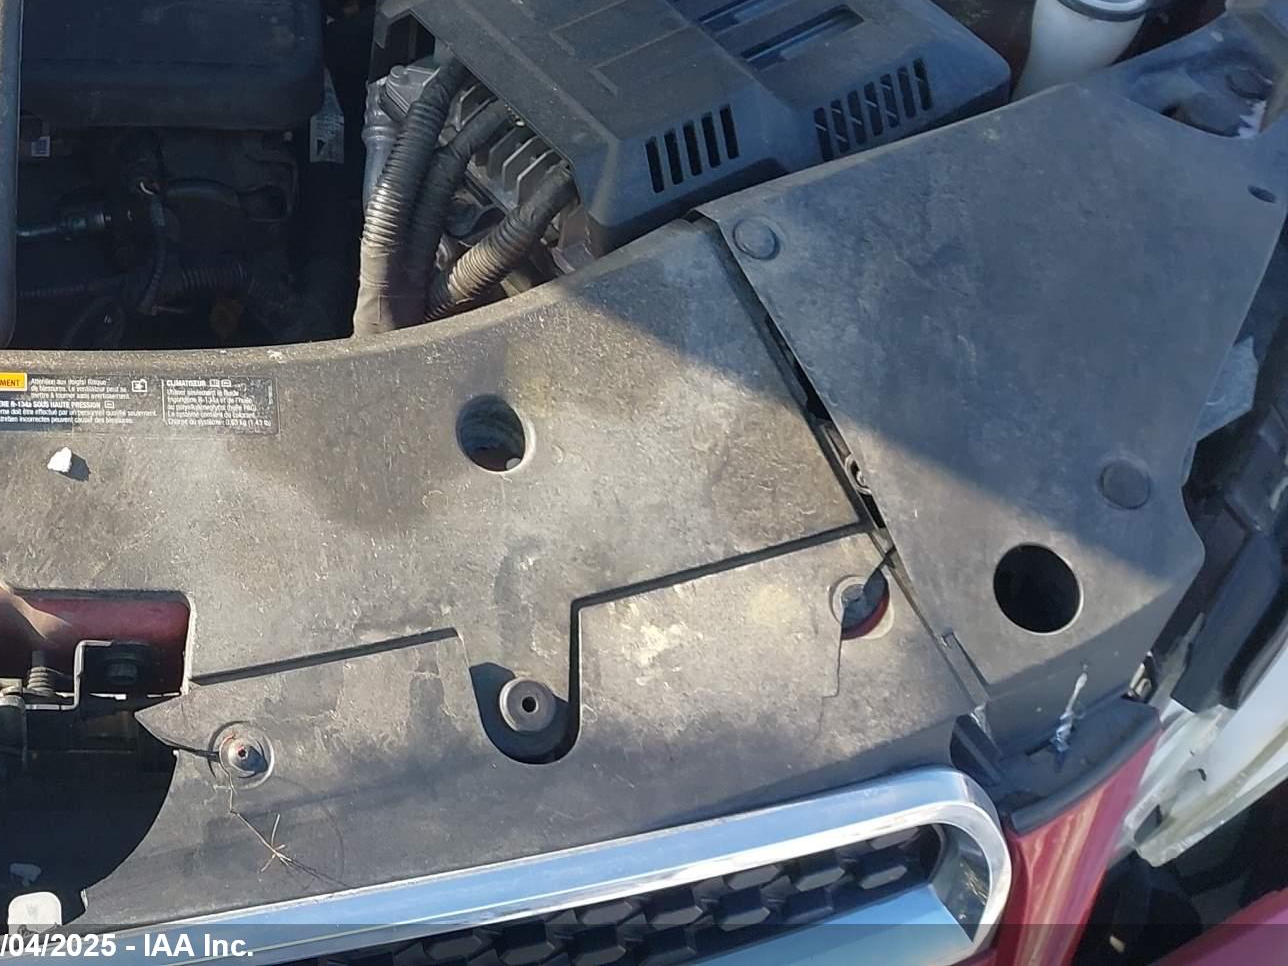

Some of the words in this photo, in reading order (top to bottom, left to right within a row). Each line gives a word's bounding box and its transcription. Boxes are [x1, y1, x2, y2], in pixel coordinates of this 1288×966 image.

[33, 400, 49, 408] SOUS
[50, 400, 70, 408] HAUTE
[71, 400, 101, 408] PRESSION
